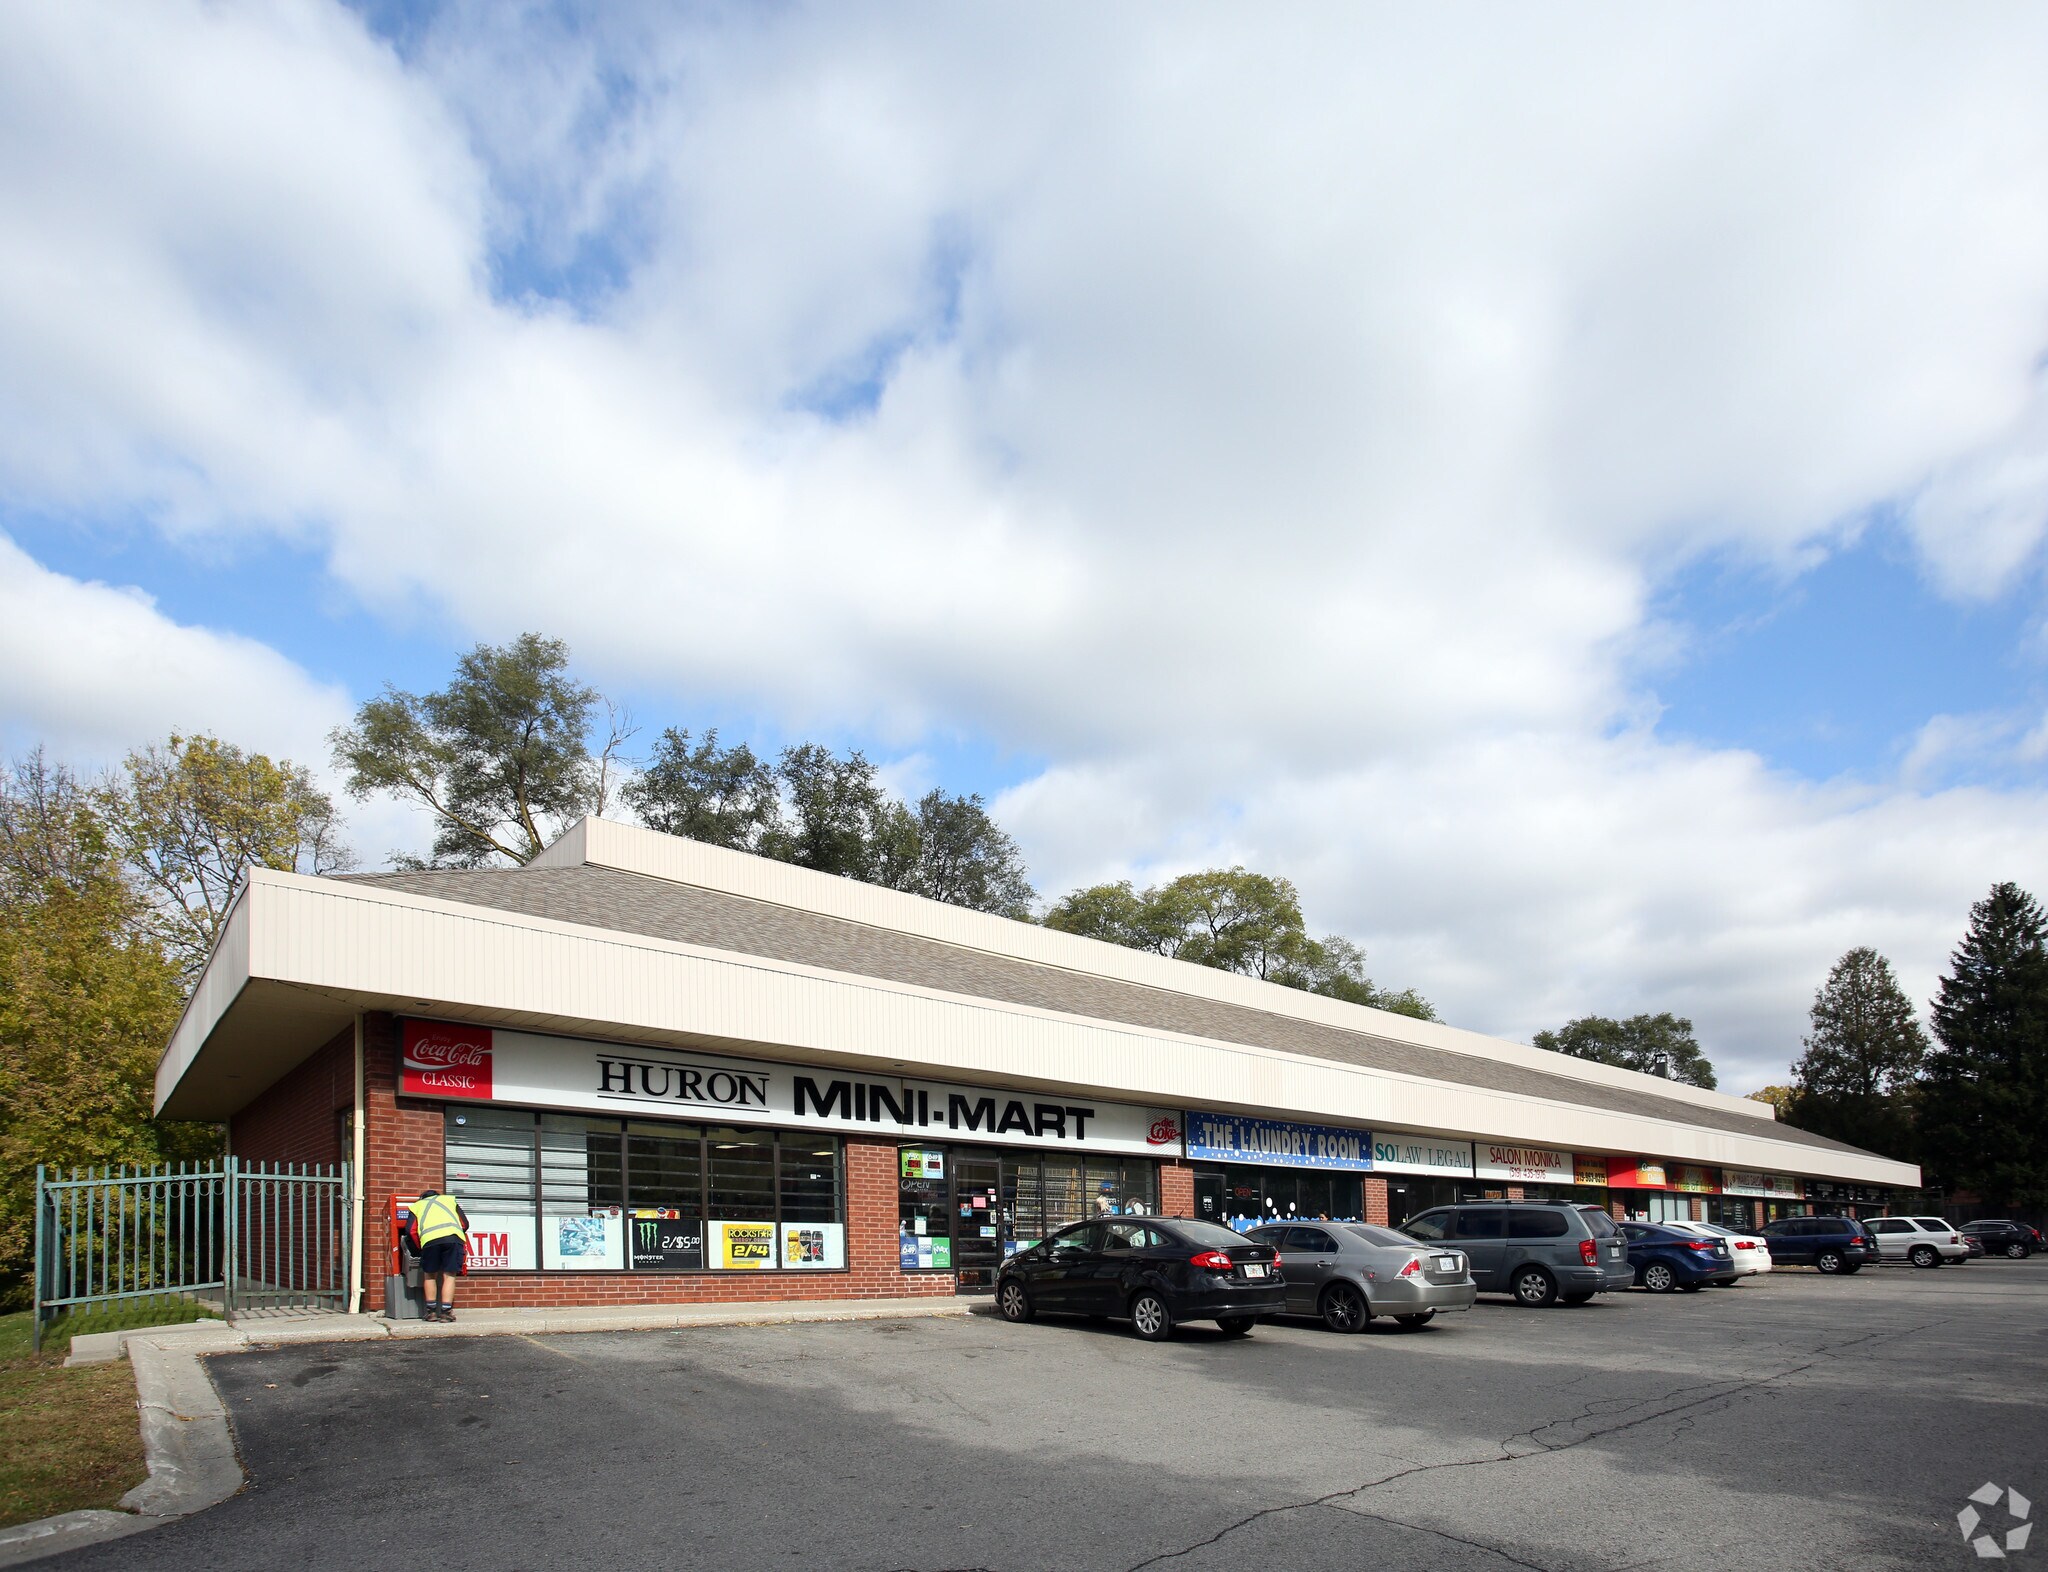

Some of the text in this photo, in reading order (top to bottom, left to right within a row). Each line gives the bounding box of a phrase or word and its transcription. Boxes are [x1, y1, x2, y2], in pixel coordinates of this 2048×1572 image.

[422, 1071, 475, 1089] CLASSIC
[597, 1060, 770, 1106] HURON
[794, 1076, 1095, 1140] MINI-MART
[1150, 1122, 1179, 1140] Coke
[1203, 1122, 1360, 1160] THE LAUNDRY ROOM
[1428, 1148, 1471, 1168] LEGAL
[1490, 1147, 1562, 1168] SALON MONIKA
[901, 1180, 930, 1190] OPEN
[1235, 1187, 1252, 1197] OPEN
